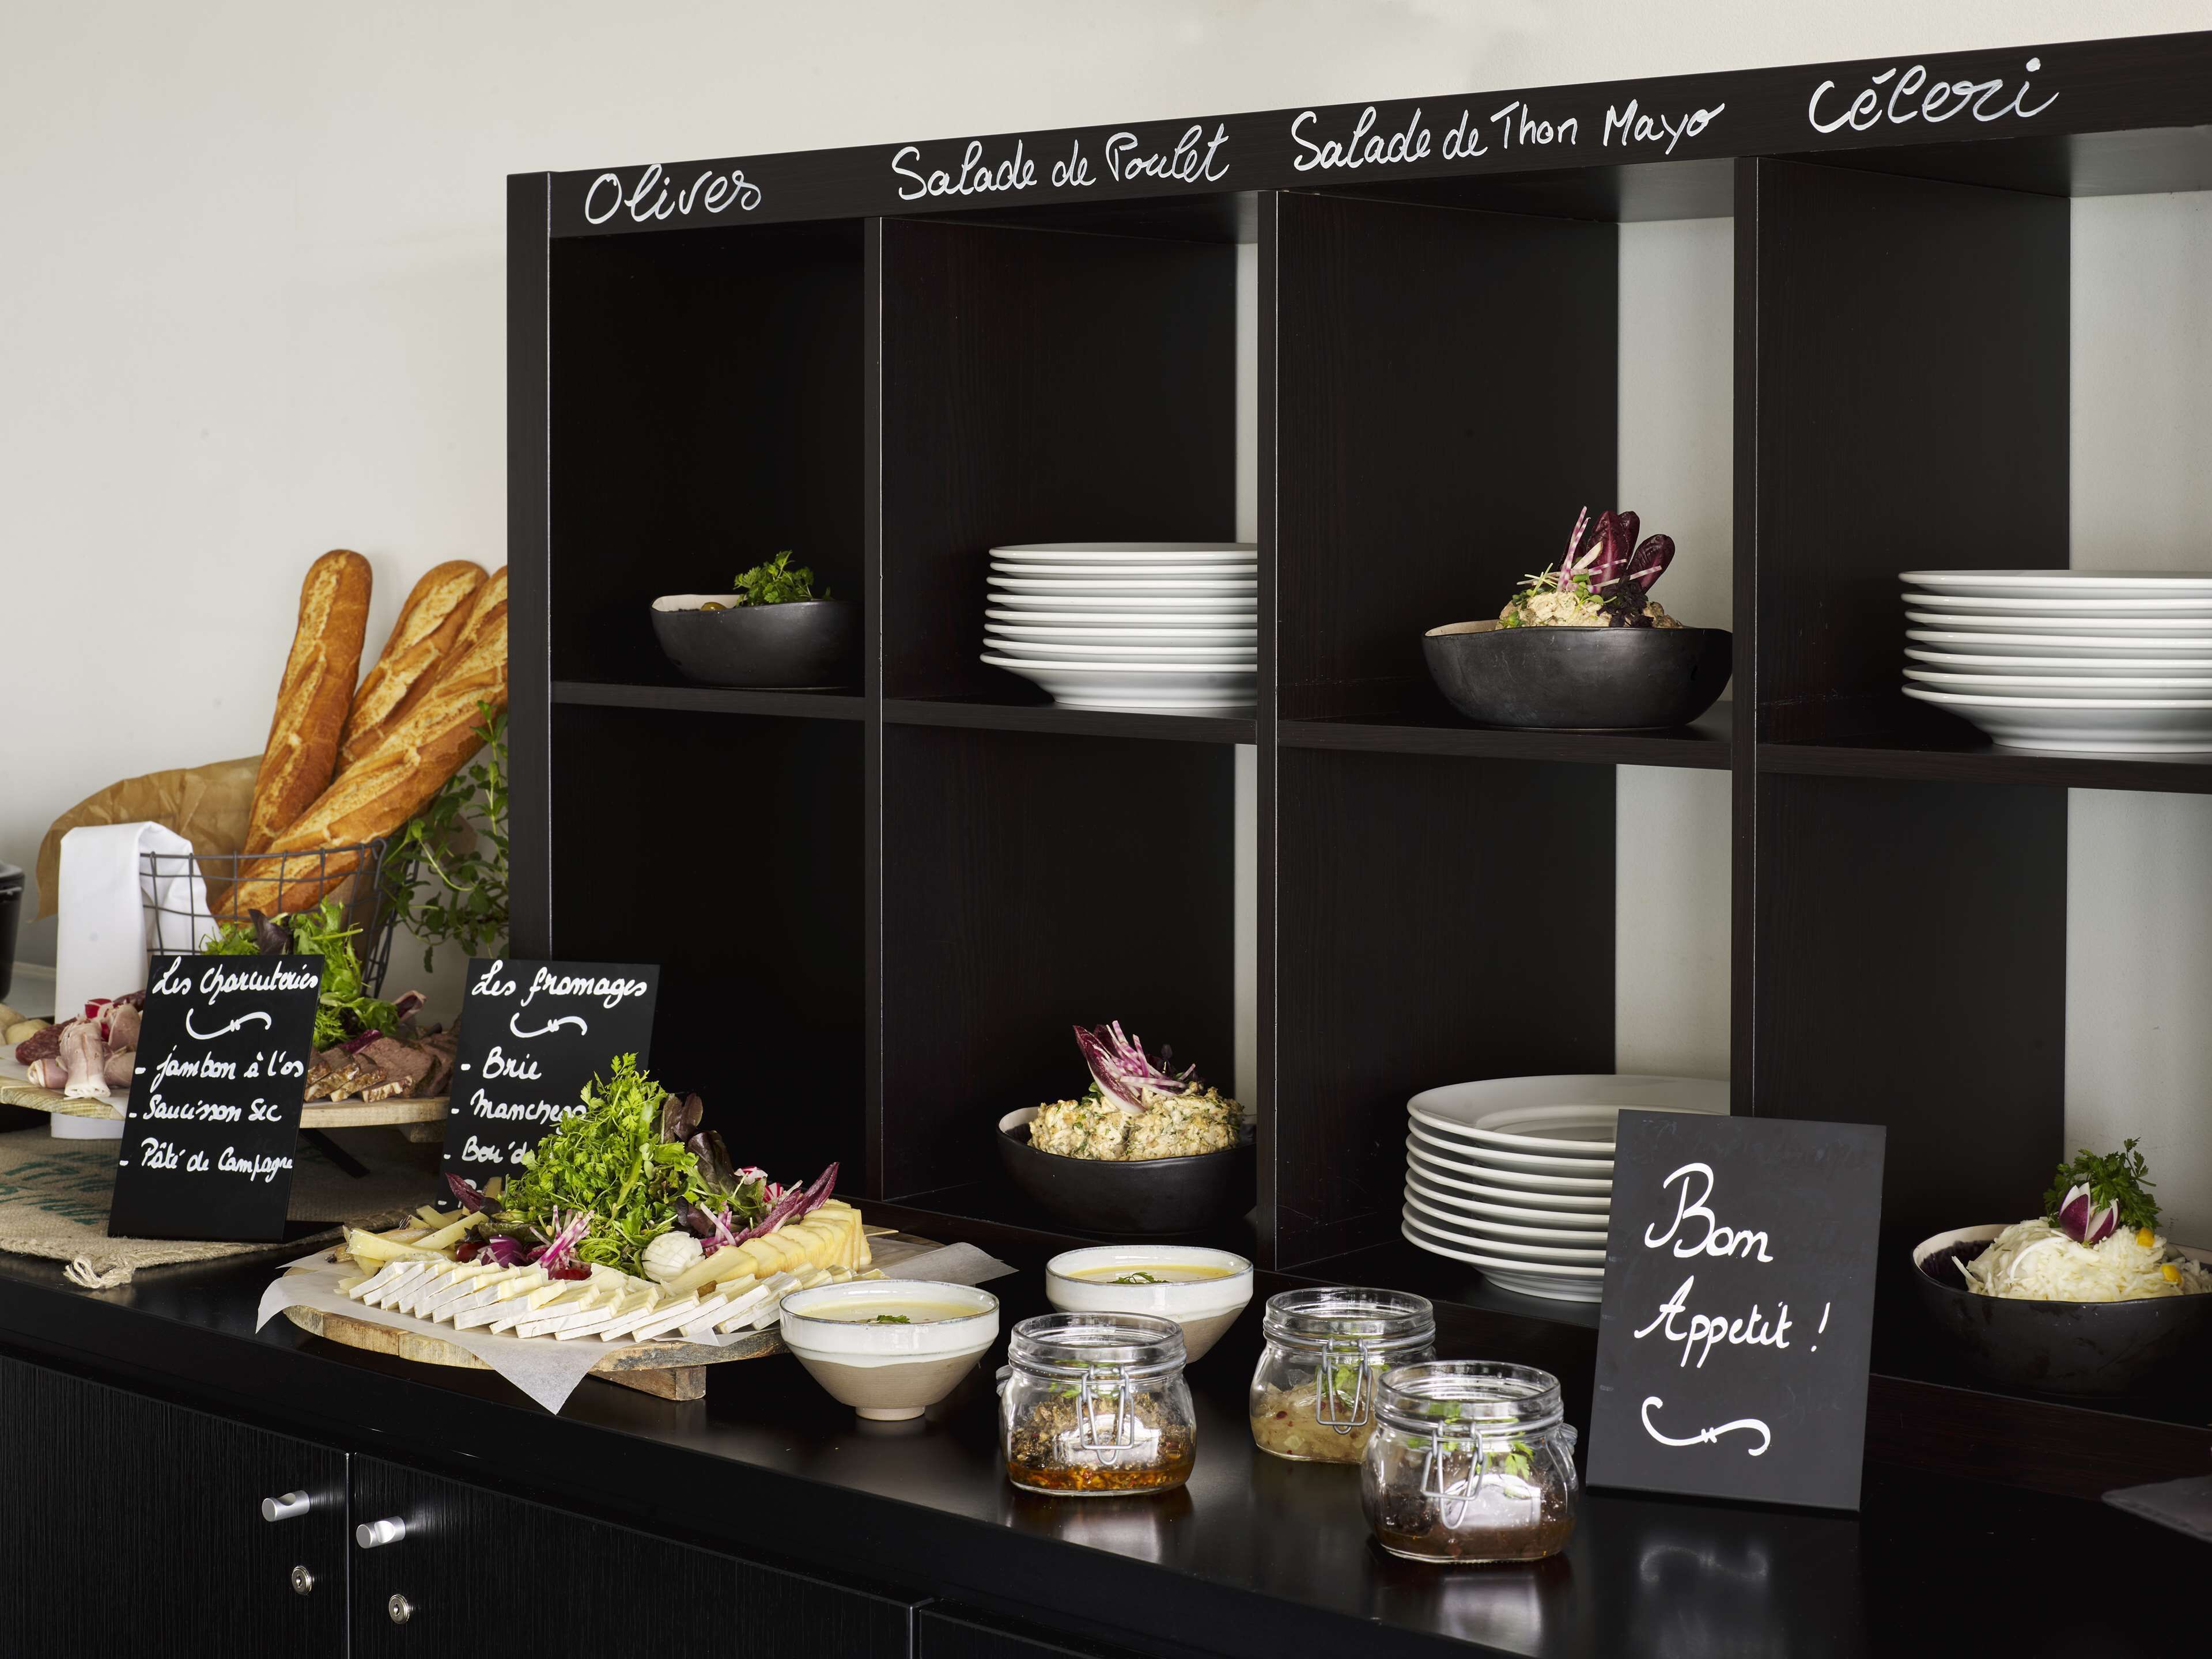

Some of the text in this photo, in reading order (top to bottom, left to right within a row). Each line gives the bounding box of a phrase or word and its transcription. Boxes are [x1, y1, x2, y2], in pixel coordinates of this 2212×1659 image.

[1808, 56, 2059, 134] Céleri
[1291, 99, 1725, 171] Salade de Thon Mayo
[891, 122, 1230, 200] Salade de Poulet
[584, 164, 762, 225] Olives
[152, 956, 192, 995] Les
[471, 959, 648, 1009] Les fromages
[243, 1051, 263, 1078] à
[267, 1050, 304, 1078] l'os
[482, 1046, 542, 1080] Brie
[142, 1094, 282, 1123] Saucisson Sec
[141, 1137, 293, 1183] Pâté de Campagne
[1634, 1275, 1793, 1369] Appetit
